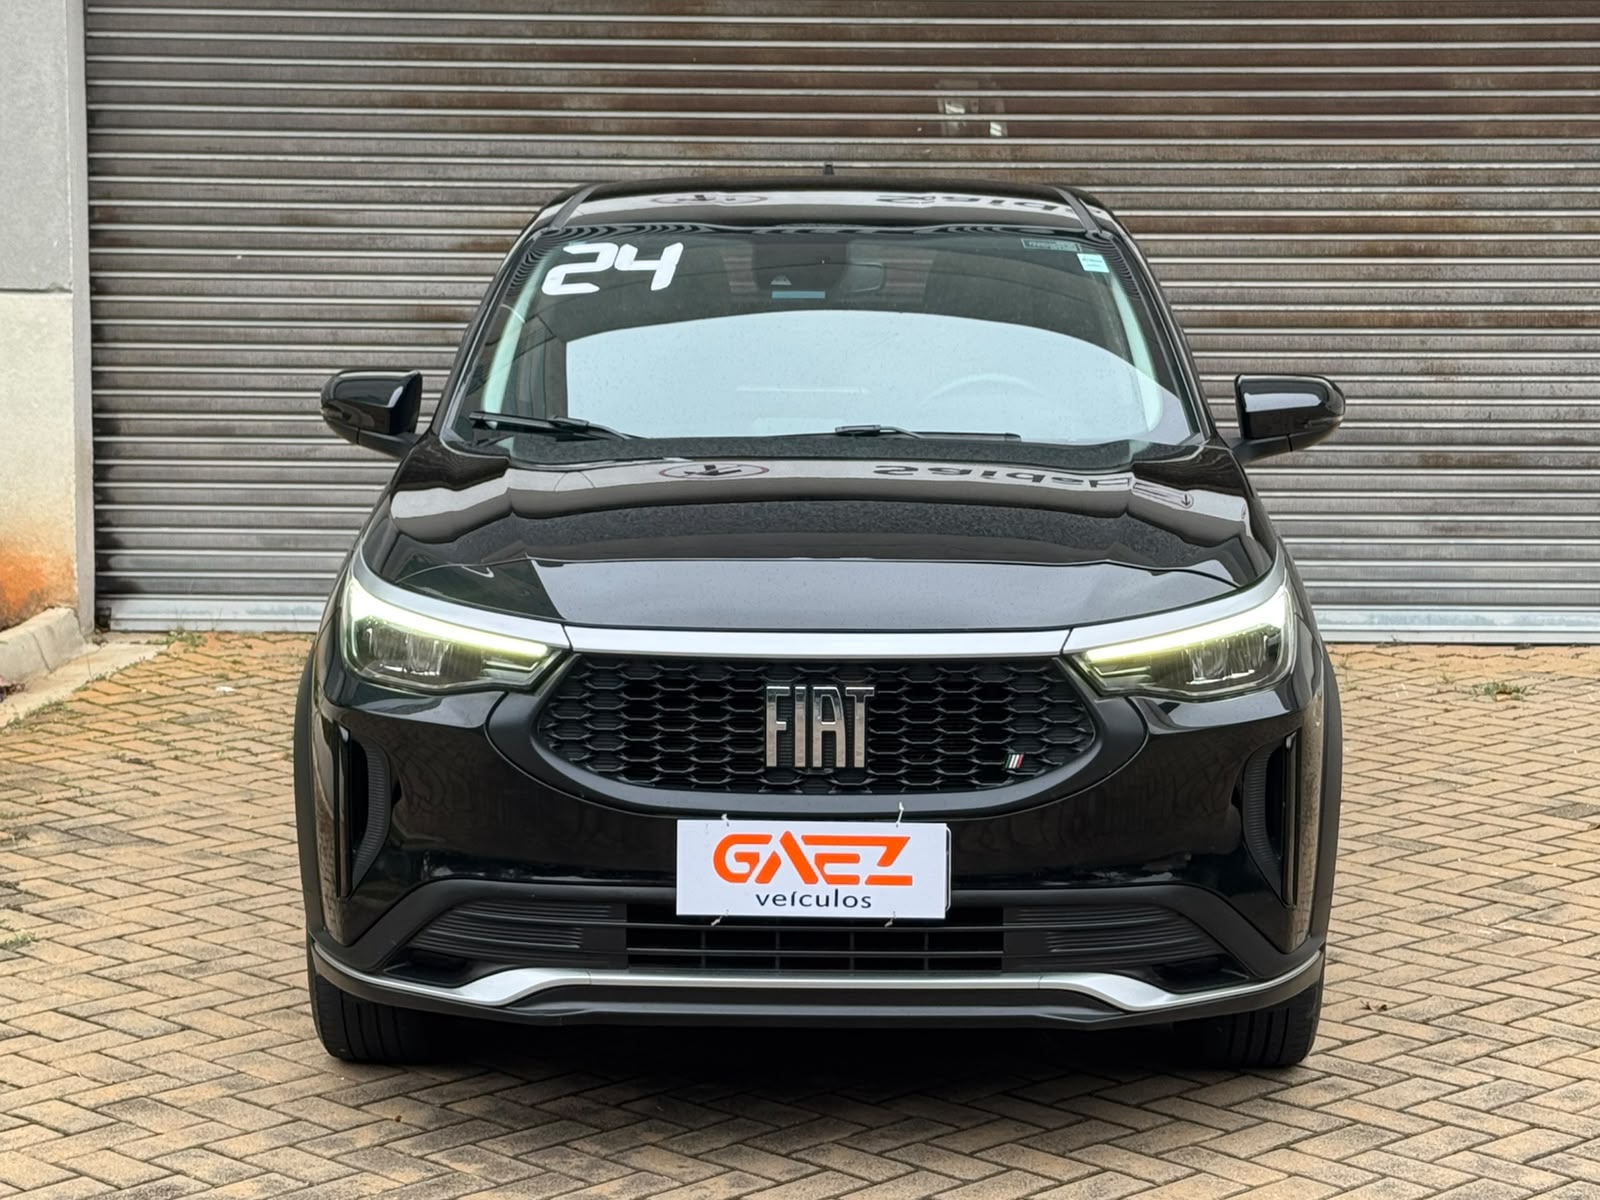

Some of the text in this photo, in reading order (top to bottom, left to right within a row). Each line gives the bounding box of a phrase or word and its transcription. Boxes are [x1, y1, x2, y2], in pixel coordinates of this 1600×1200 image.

[541, 242, 684, 296] 24
[765, 686, 875, 768] FIAT
[713, 830, 913, 886] GAEZ
[755, 888, 872, 909] veículos
